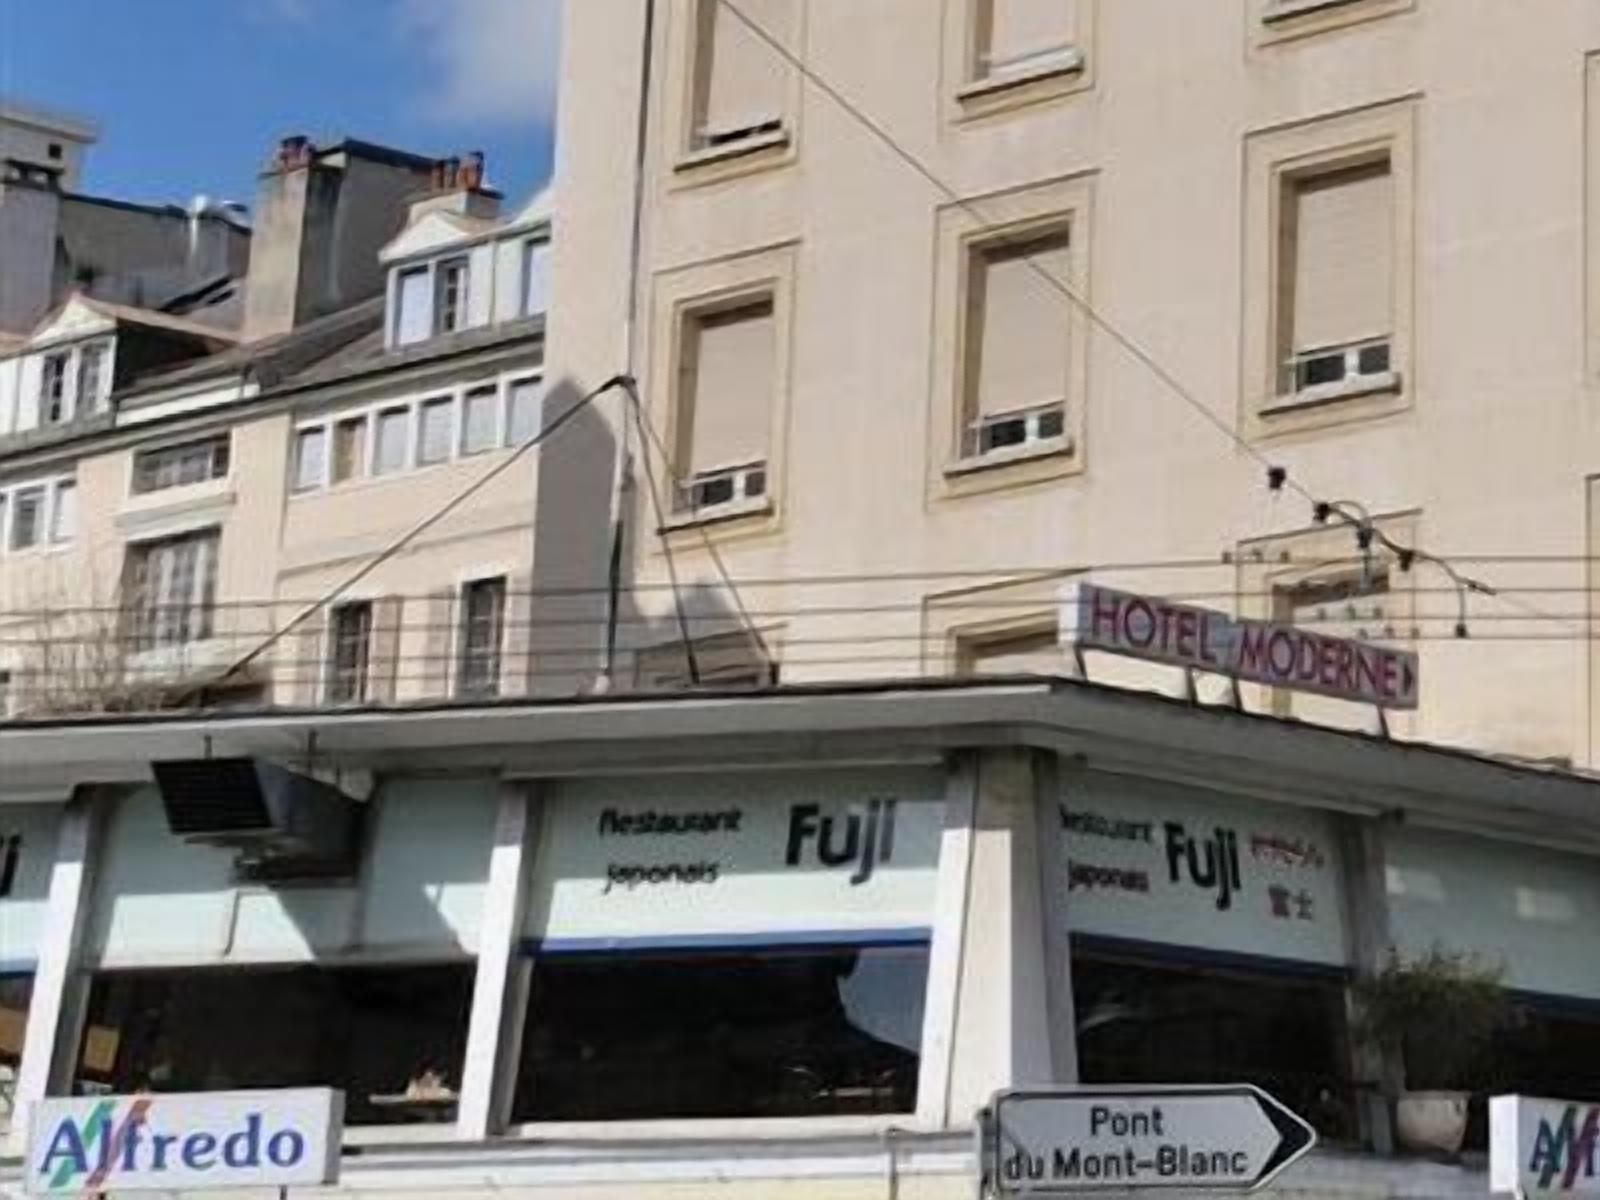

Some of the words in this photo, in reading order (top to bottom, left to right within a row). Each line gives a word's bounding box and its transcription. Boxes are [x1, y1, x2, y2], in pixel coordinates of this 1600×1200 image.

[1091, 588, 1217, 665] HOTEL
[1237, 624, 1398, 698] MODERNE
[599, 806, 743, 837] Restaurant
[785, 798, 899, 886] Fuji
[603, 862, 720, 895] japonais
[1163, 820, 1241, 911] Fuji
[40, 1100, 304, 1182] Alfredo
[1090, 1105, 1164, 1137] Pont
[1003, 1147, 1044, 1180] du
[1053, 1145, 1250, 1178] Mont-Blanc
